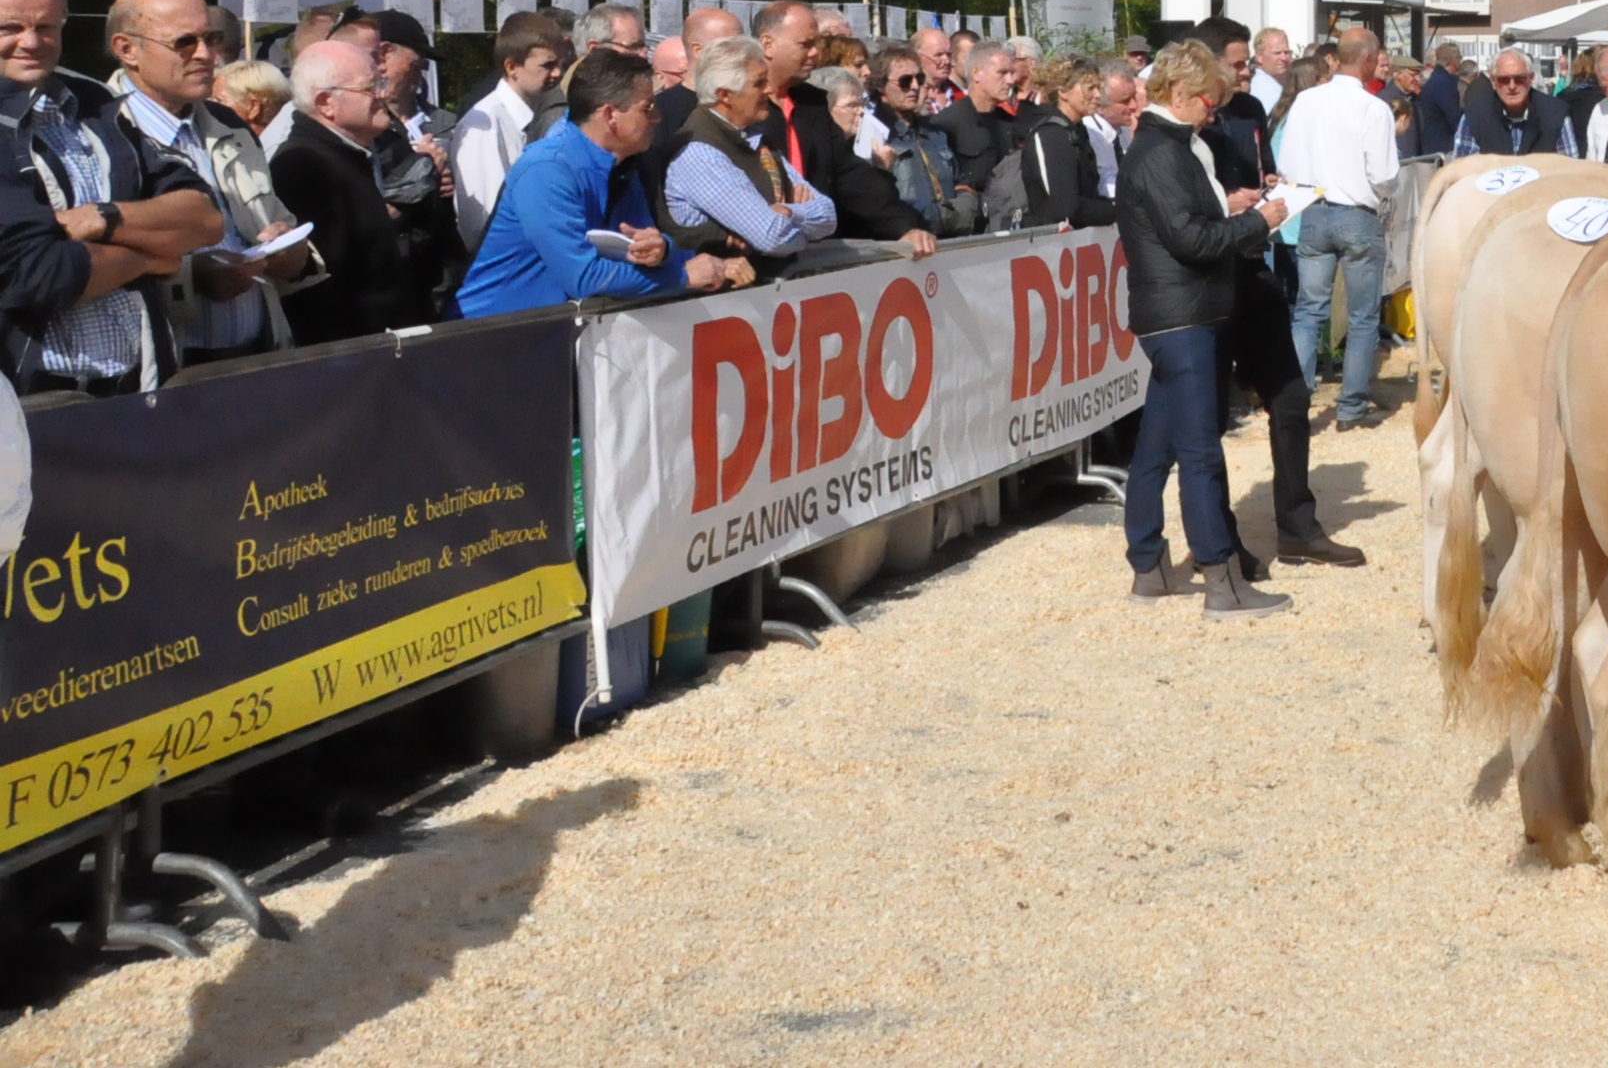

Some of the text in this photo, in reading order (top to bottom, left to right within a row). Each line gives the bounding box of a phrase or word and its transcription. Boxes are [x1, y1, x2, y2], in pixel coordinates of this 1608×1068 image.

[1485, 170, 1526, 192] 37
[1008, 369, 1139, 447] CLEANING SYSTEMS
[235, 480, 525, 579] Bedrijfsbegeleiding & bedrijfsadvies
[239, 473, 328, 520] Apotheek
[686, 446, 933, 573] CLEANING SYSTEMS
[237, 519, 548, 636] Consult zieke runderen & spoedbezoek
[1, 635, 201, 723] veedierenartsen
[5, 774, 36, 829] F
[48, 738, 136, 809] 0573
[147, 710, 214, 765] 402
[223, 686, 274, 743] 535
[312, 659, 342, 706] W
[355, 581, 543, 688] www.agrivets.nl
